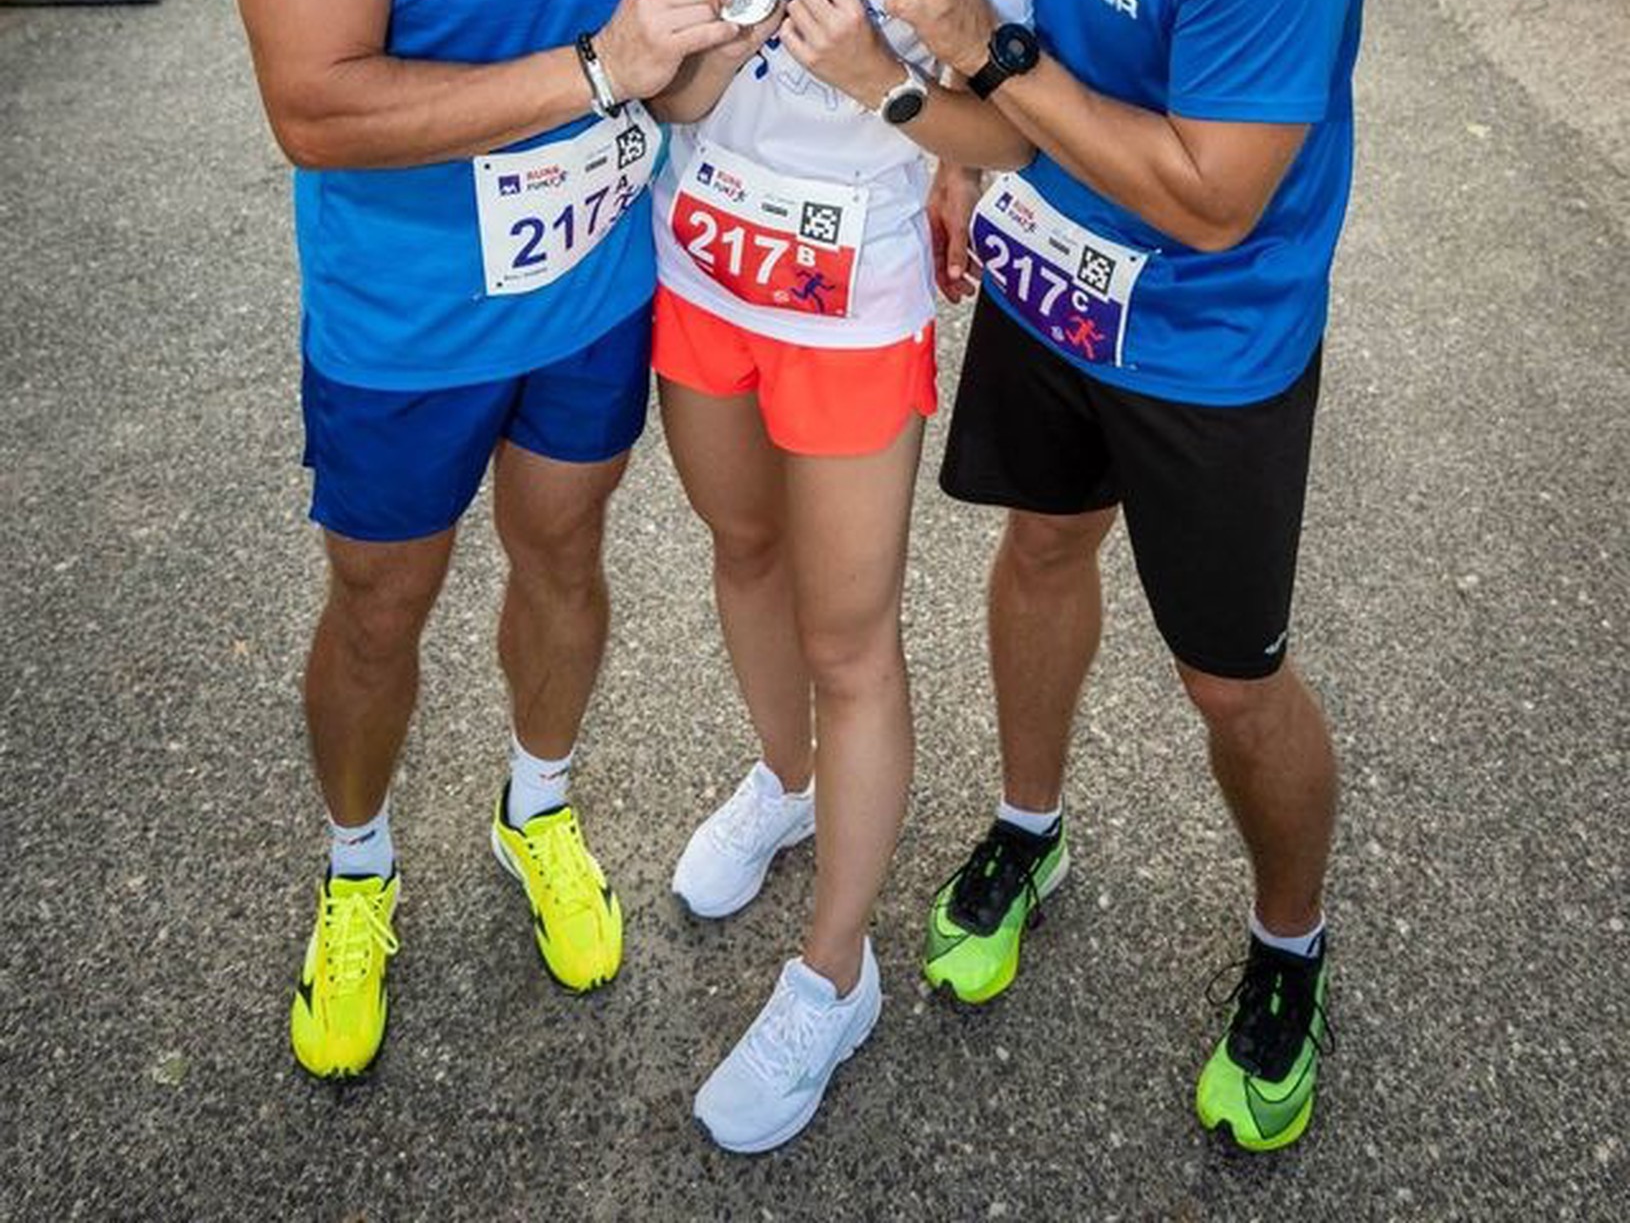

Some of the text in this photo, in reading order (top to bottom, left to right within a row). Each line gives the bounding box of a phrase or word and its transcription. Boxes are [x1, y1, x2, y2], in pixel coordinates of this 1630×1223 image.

[510, 185, 611, 269] 217
[688, 211, 816, 285] 217 B
[985, 234, 1089, 317] 217 C
